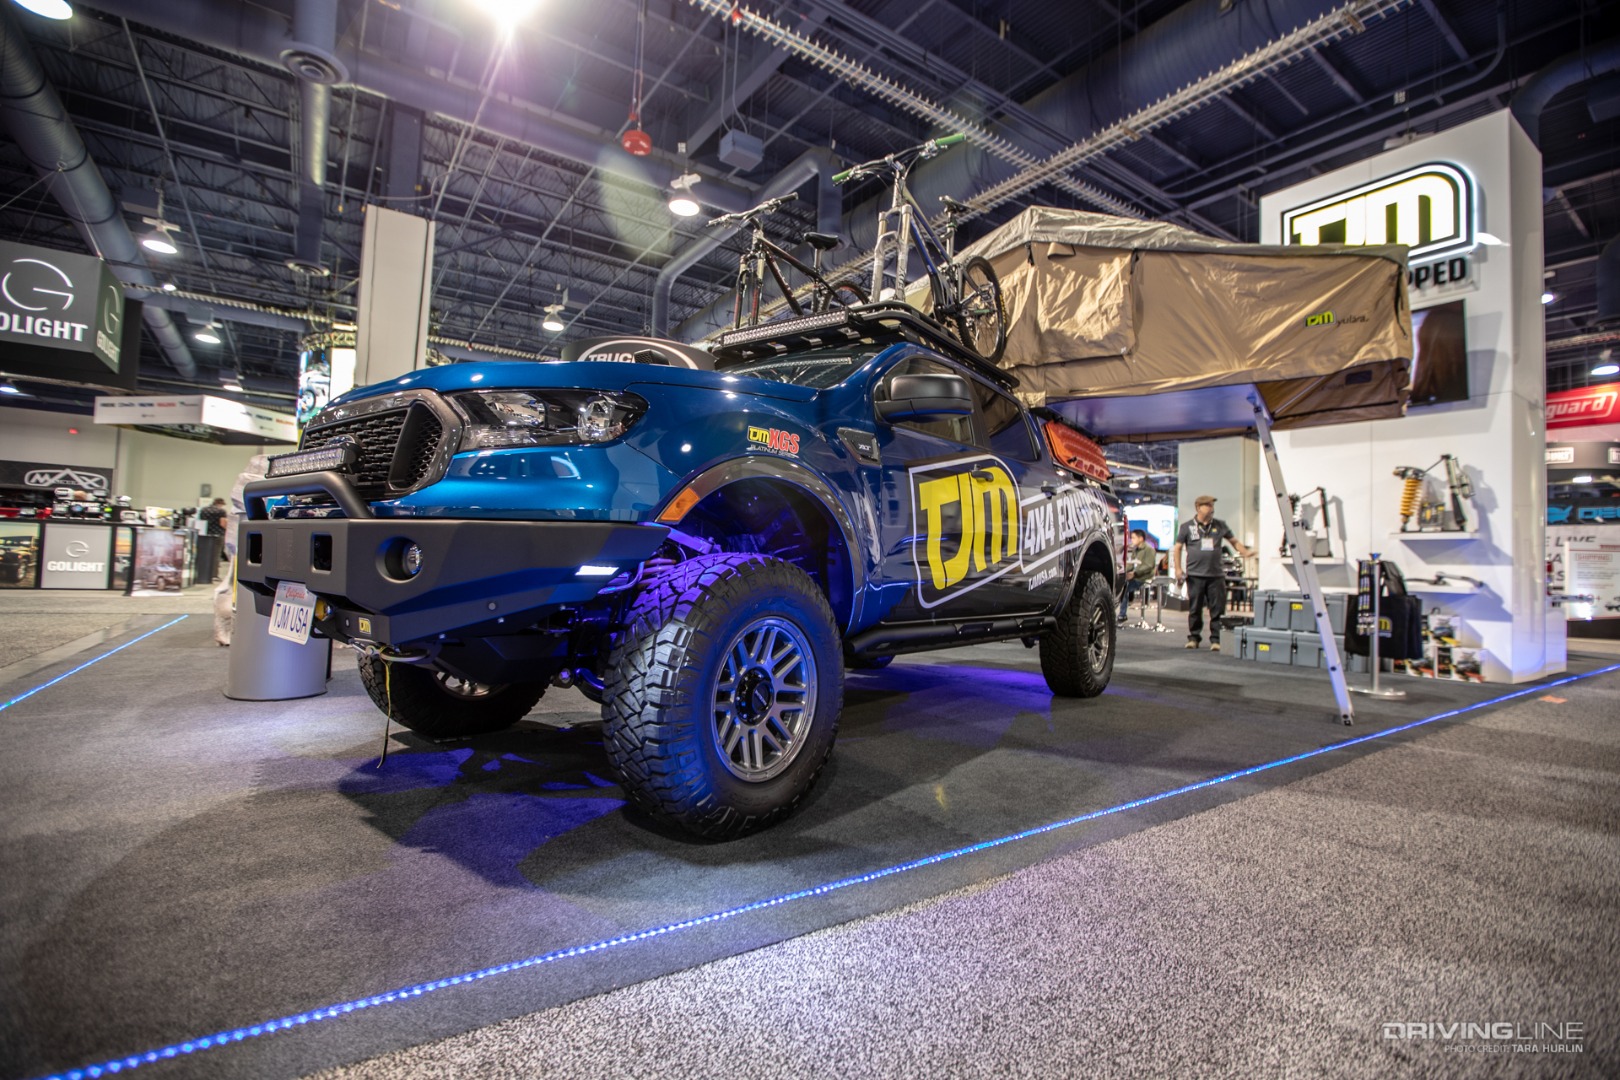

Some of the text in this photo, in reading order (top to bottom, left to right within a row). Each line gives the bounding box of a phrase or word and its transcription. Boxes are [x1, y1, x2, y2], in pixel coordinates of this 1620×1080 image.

[589, 352, 635, 363] TRUC
[768, 428, 800, 454] XGS
[919, 465, 1017, 591] TJM
[1024, 503, 1056, 556] 4X4
[47, 561, 105, 572] GOLIGHT
[274, 603, 309, 635] TJM USA
